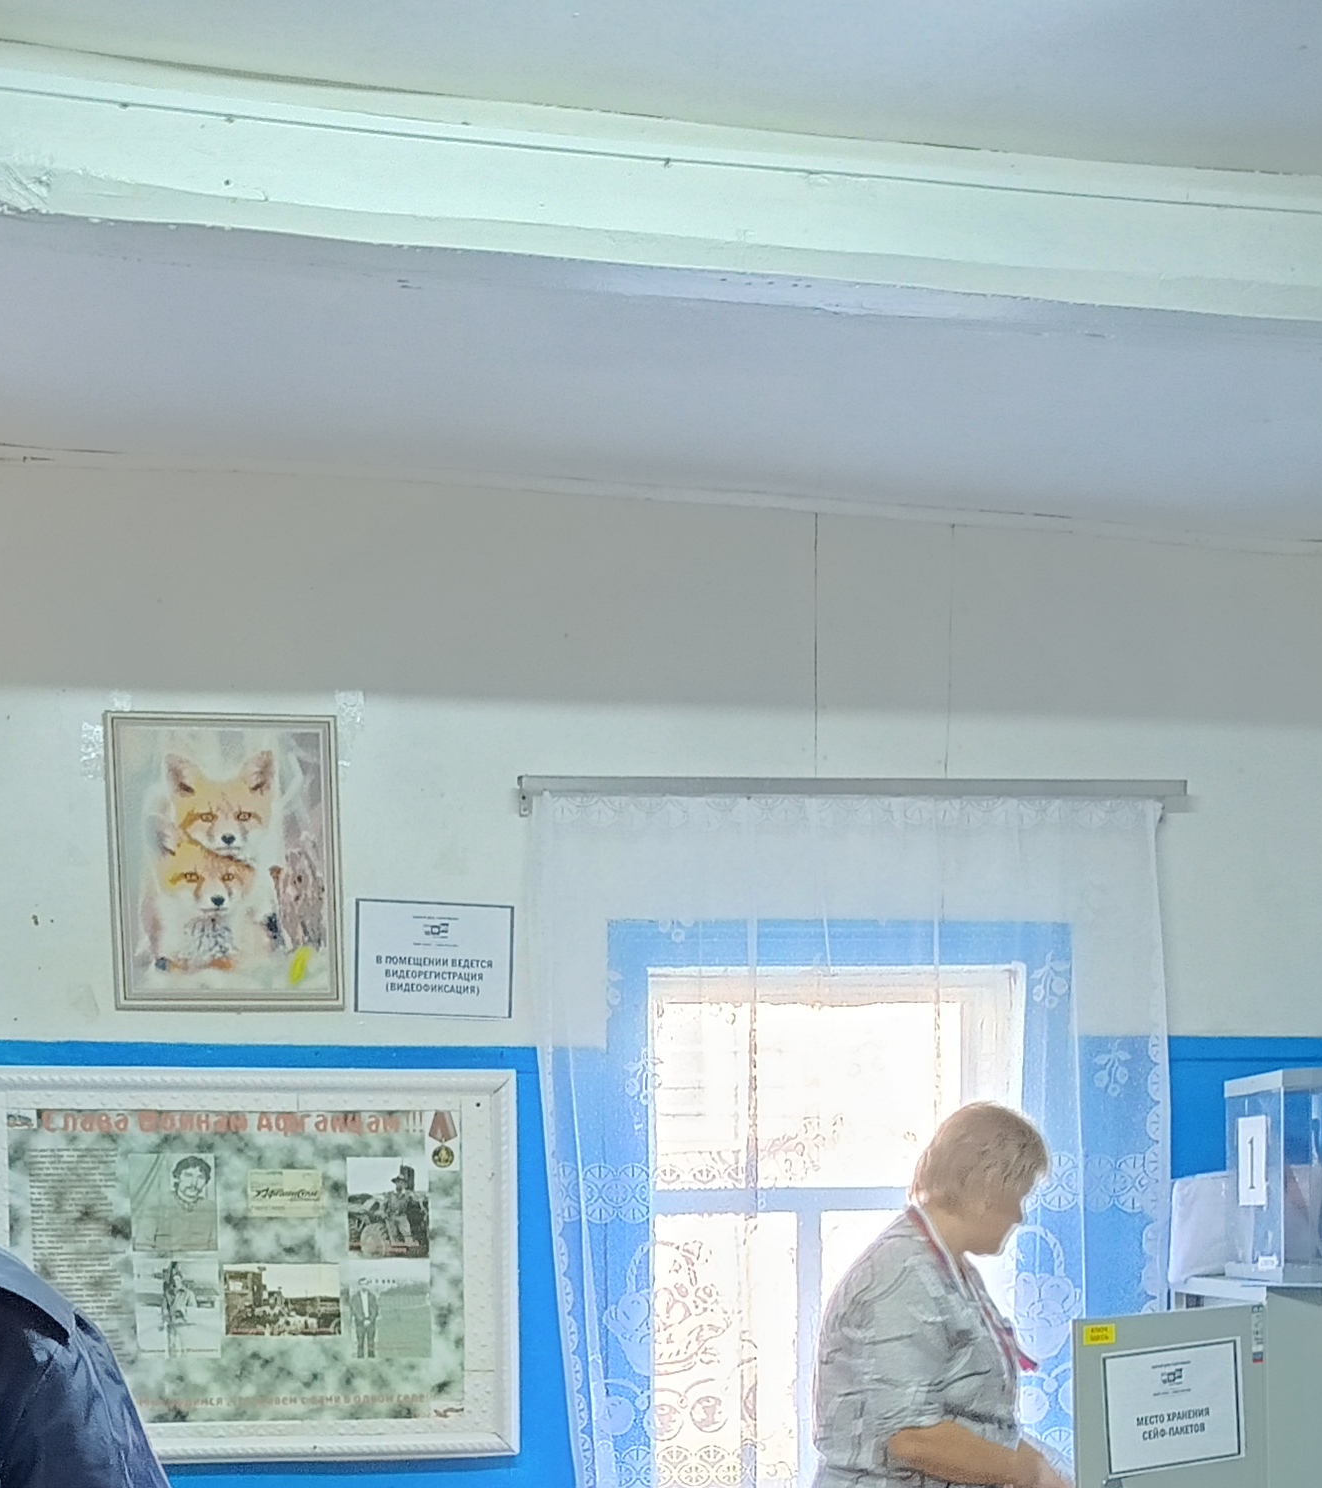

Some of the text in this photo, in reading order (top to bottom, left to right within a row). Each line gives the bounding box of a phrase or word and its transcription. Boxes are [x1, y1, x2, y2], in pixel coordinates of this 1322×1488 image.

[375, 954, 493, 969] В ПОМЕЩЕНИИ ВЕДЕТСЯ
[384, 968, 484, 983] ВИДЕОРЕГИСТРАЦИЯ
[385, 982, 481, 996] (ВИДЕОФИКСАЦИЯ)
[42, 1110, 128, 1133] Слава
[1136, 1407, 1211, 1427] МЕСТО ХРАНЕНИЯ
[1142, 1422, 1206, 1441] СЕЙФ-ПАКЕТОВ
